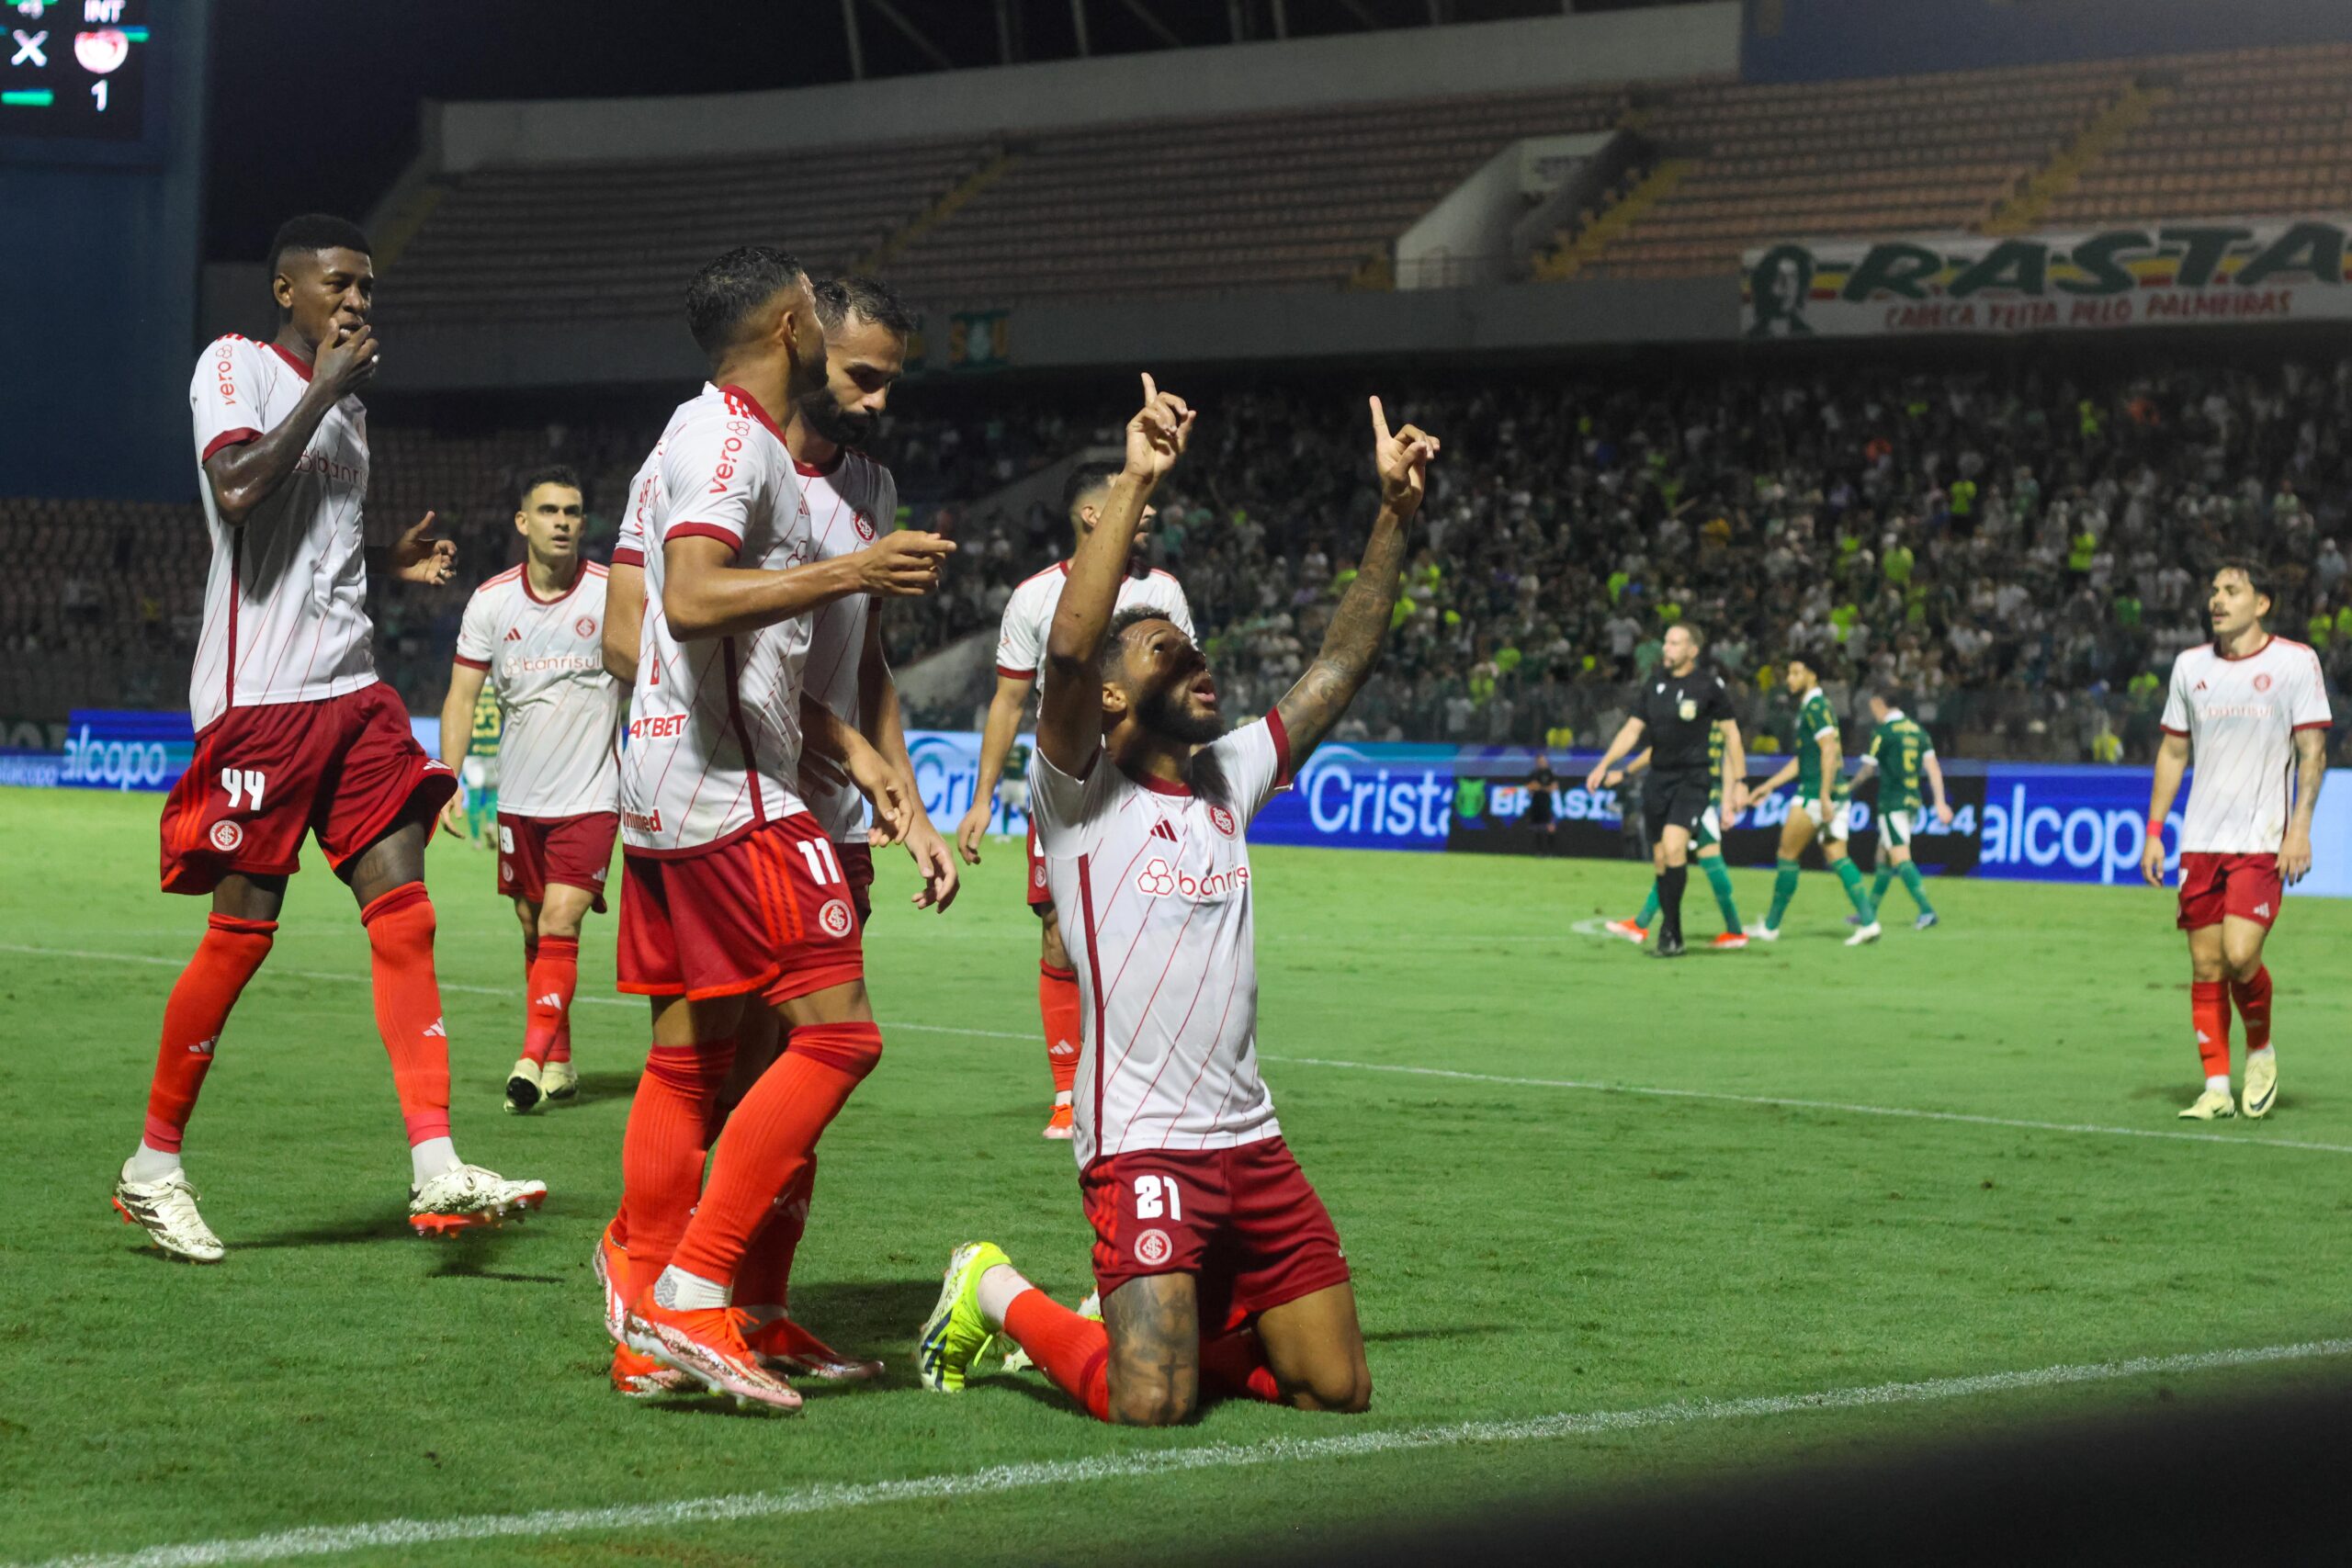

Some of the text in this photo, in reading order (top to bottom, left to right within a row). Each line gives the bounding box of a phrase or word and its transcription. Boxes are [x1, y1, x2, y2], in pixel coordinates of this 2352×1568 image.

[91, 79, 107, 111] 1
[1842, 223, 2346, 302] RASTA
[218, 360, 236, 406] vero
[708, 436, 742, 495] vero
[62, 723, 167, 793] alcopo
[221, 767, 266, 812] 44
[796, 837, 841, 886] 11
[1134, 1175, 1182, 1221] 21
